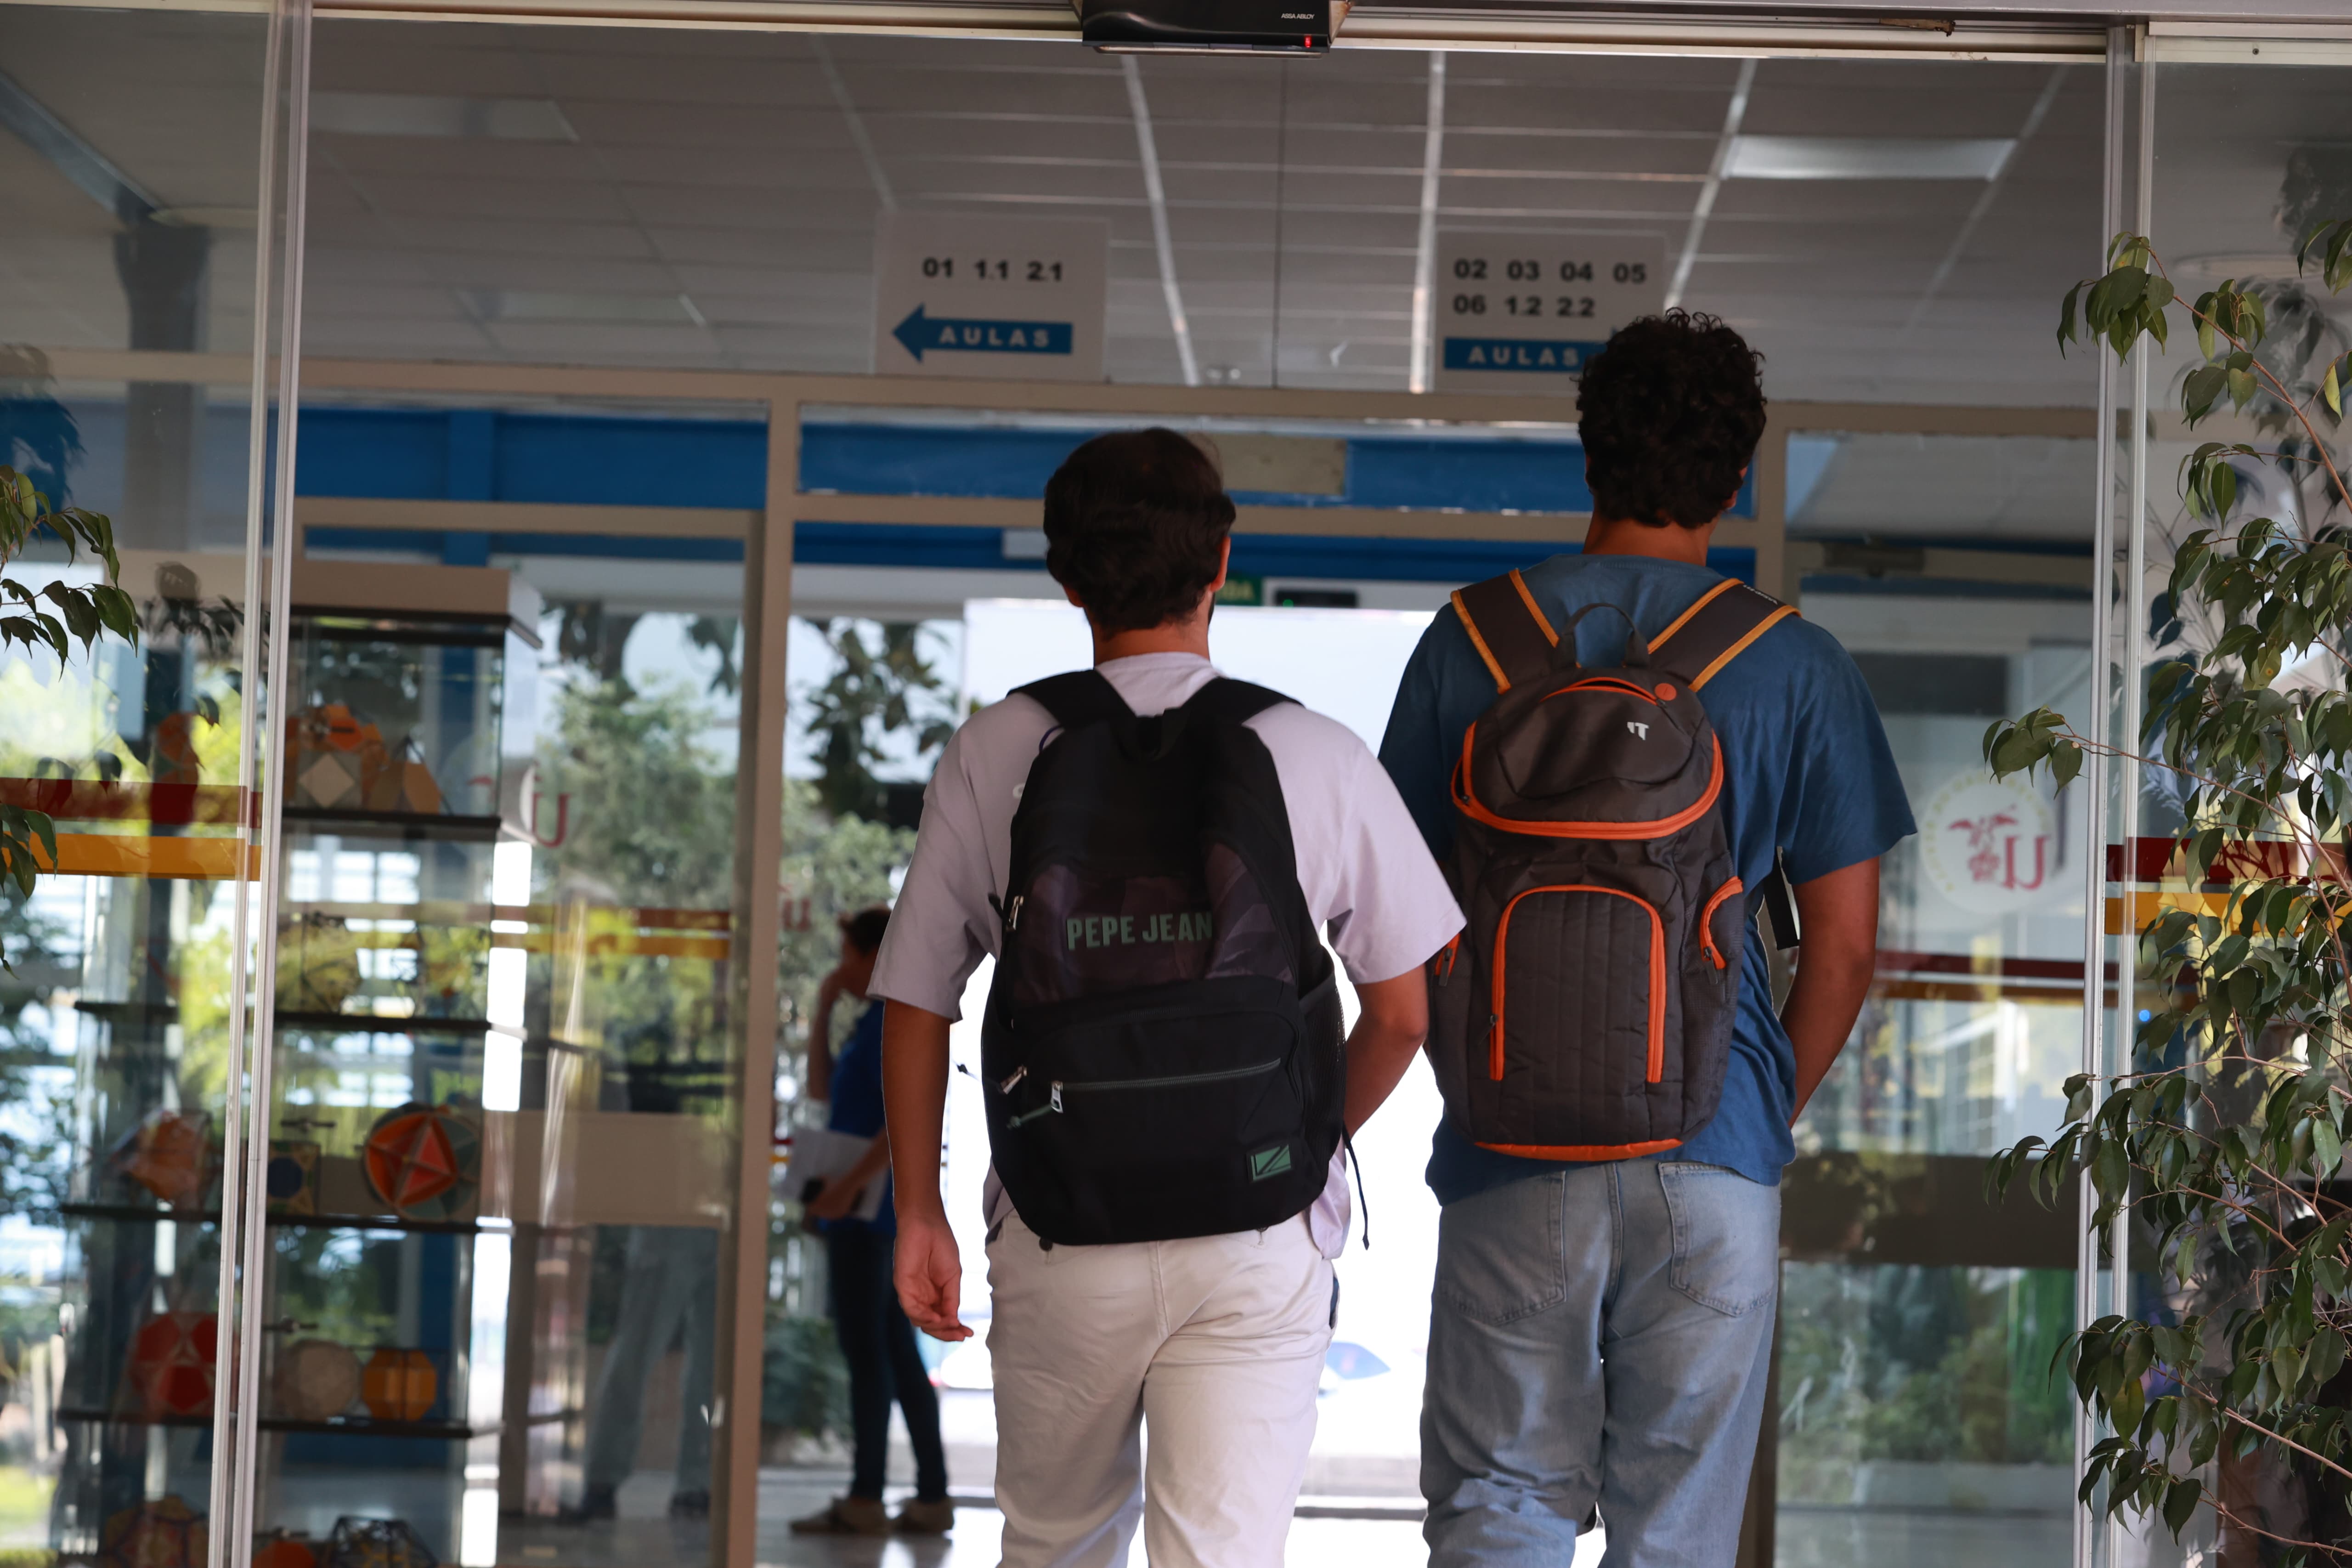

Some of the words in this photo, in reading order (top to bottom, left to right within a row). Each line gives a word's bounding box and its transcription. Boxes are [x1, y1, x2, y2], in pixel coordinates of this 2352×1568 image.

[922, 257, 954, 278] 01
[1453, 258, 1488, 280] 02
[1507, 260, 1540, 281] 03
[1560, 261, 1594, 282] 04
[1612, 262, 1647, 284] 05
[1453, 293, 1487, 315] 06
[939, 326, 1049, 347] AULAS
[1468, 345, 1579, 366] AULAS
[1066, 916, 1136, 951] PEPE
